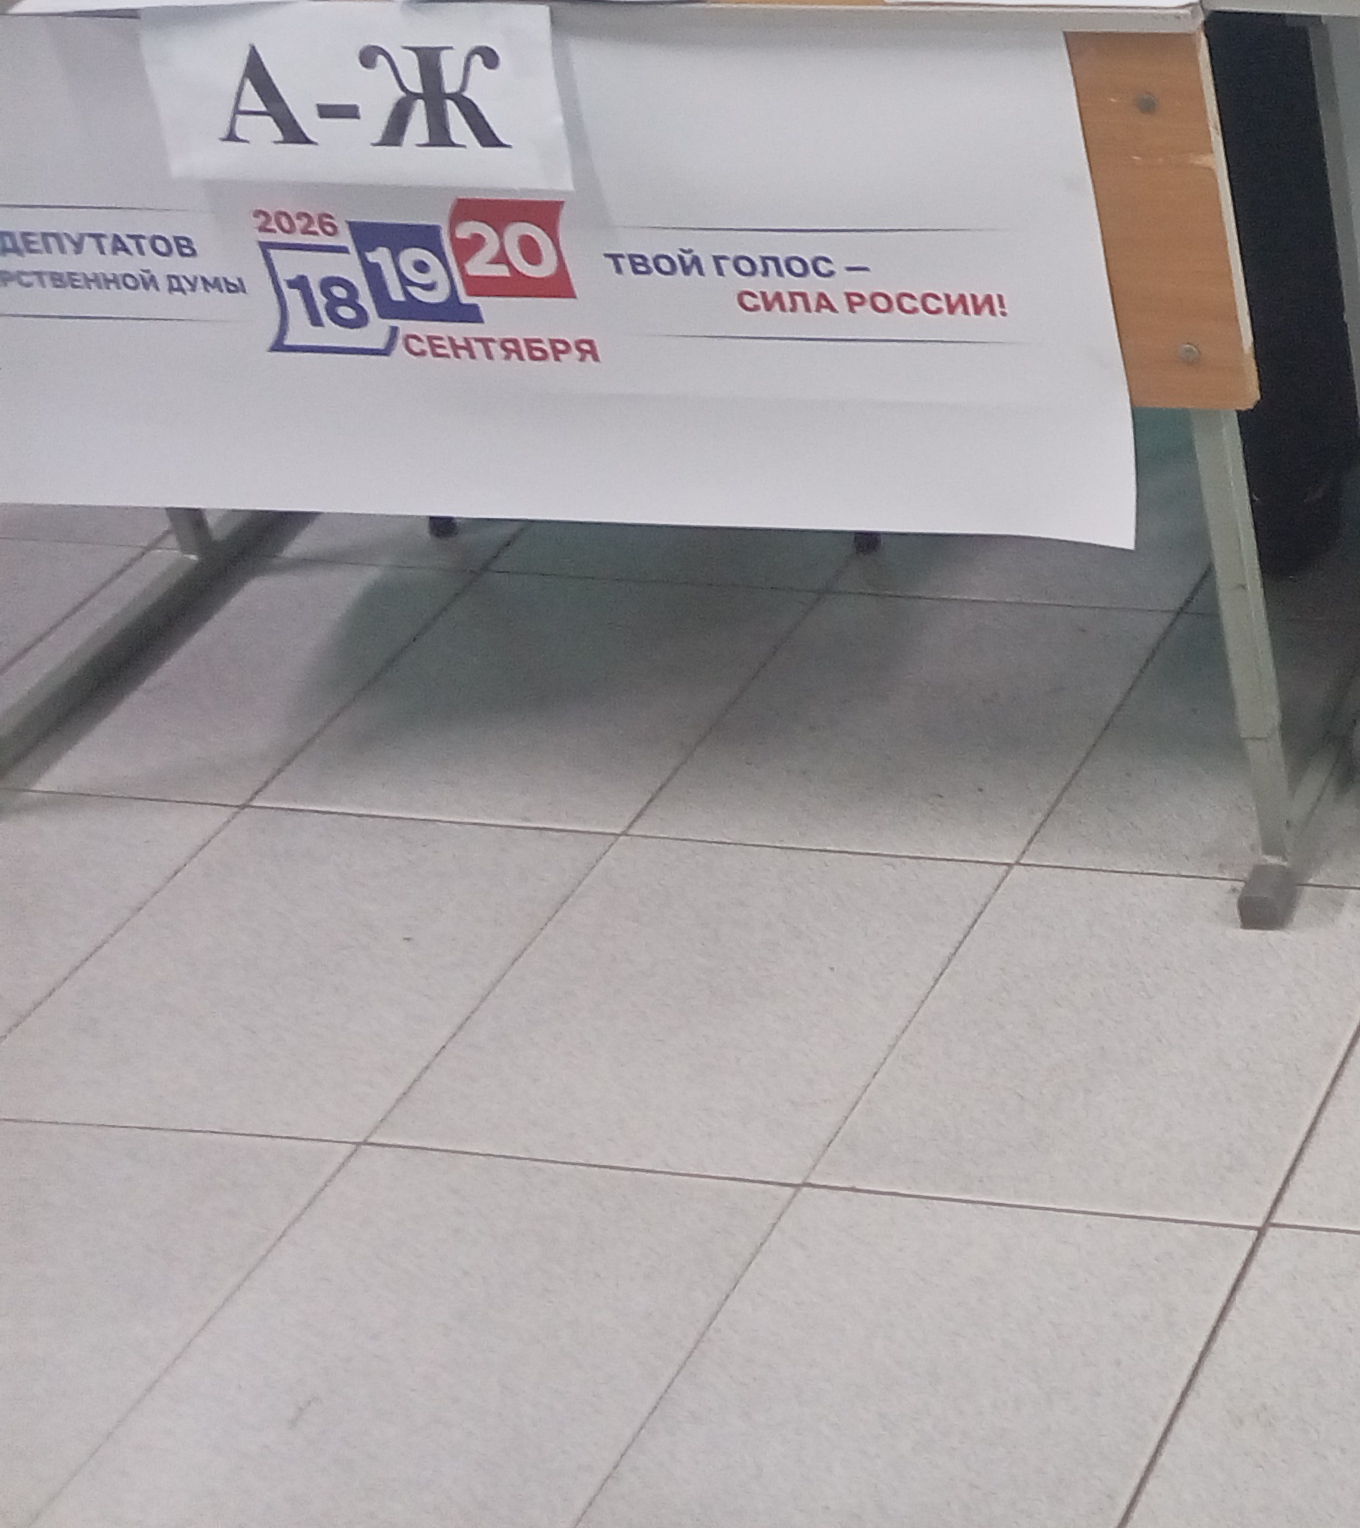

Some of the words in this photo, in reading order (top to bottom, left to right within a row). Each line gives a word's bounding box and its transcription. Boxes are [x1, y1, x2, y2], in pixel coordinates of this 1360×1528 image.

[219, 43, 513, 149] А-Ж
[252, 209, 339, 236] 2026
[0, 230, 198, 258] ДЕПУТАТОВ
[454, 221, 558, 278] 20
[364, 247, 451, 304] 19
[602, 248, 706, 277] ТВОЙ
[711, 254, 837, 279] ГОЛОС
[166, 273, 248, 296] ДУМЫ
[284, 274, 371, 330] 18
[736, 290, 839, 314] СИЛА
[846, 291, 1008, 317] РОССИИ!
[402, 333, 601, 364] СЕНТЯБРЯ
